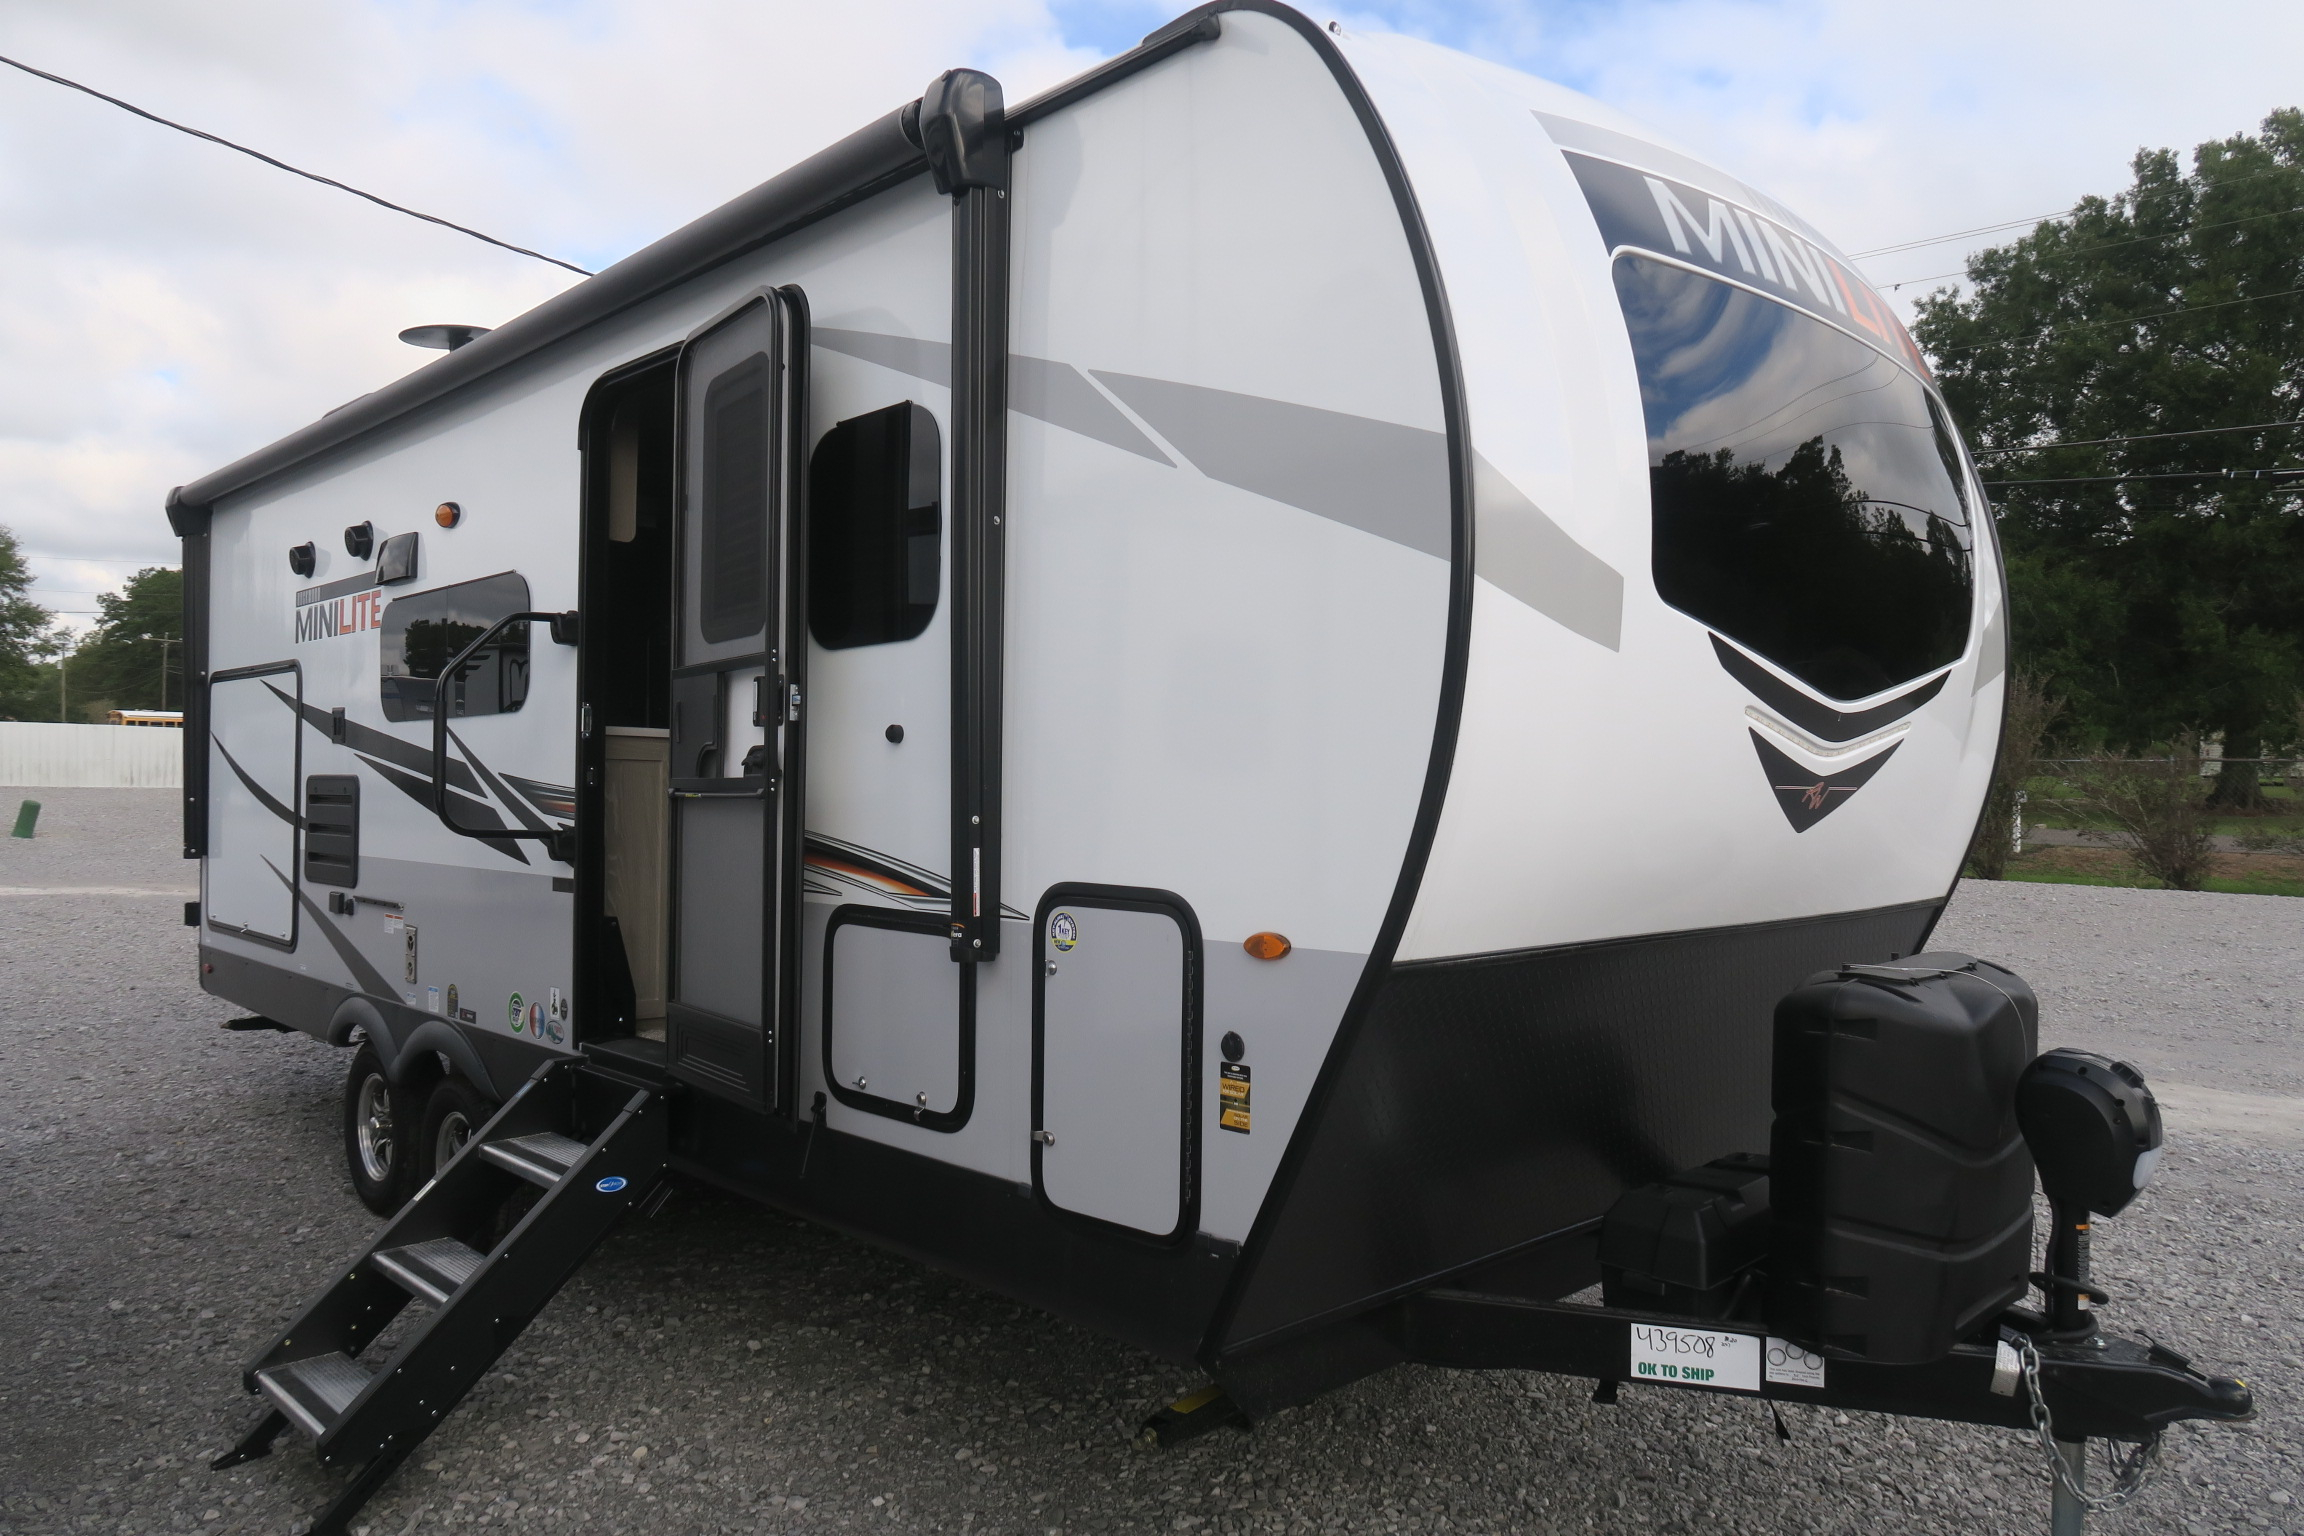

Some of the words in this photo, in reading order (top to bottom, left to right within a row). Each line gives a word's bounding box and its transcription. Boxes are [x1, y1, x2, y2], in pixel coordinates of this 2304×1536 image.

[295, 589, 382, 644] MINILITE
[1222, 1084, 1244, 1092] WIRED
[1636, 1326, 1715, 1358] 439508
[1637, 1361, 1657, 1375] OK
[1661, 1364, 1678, 1378] TO
[1681, 1366, 1715, 1381] SHIP
